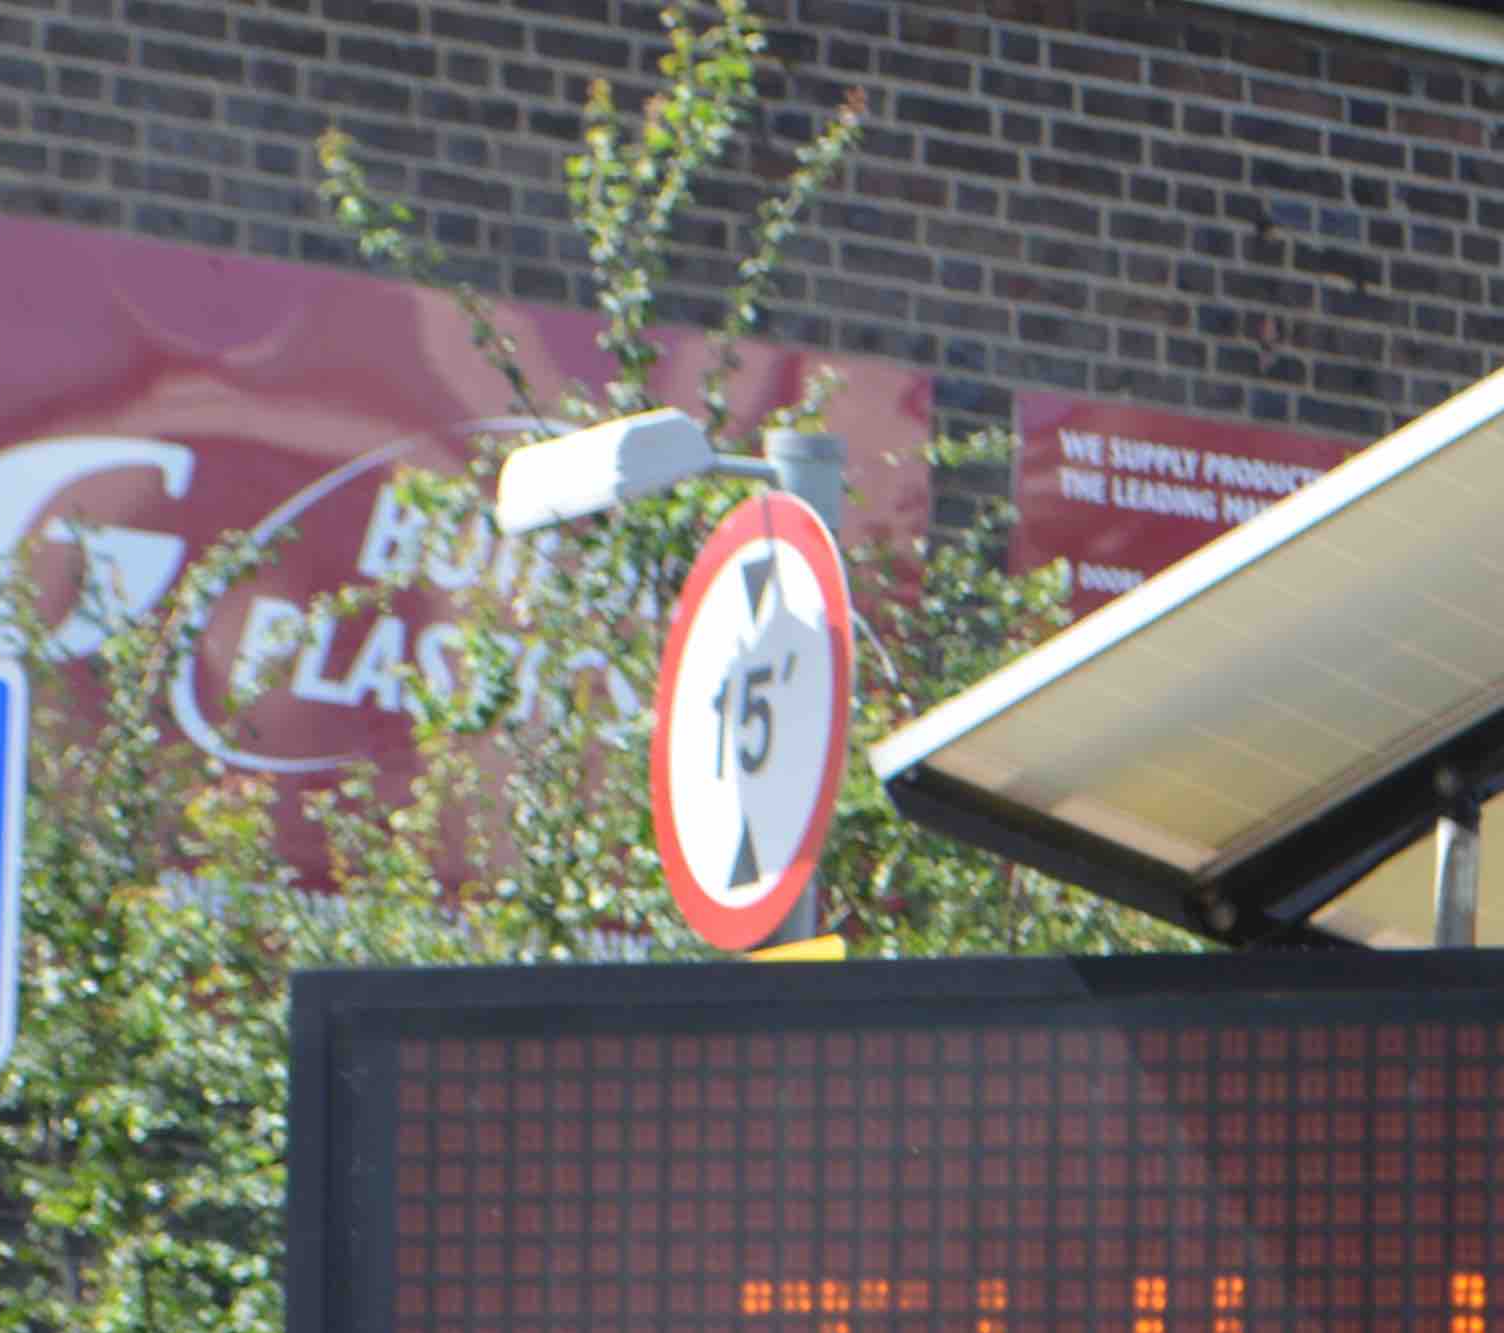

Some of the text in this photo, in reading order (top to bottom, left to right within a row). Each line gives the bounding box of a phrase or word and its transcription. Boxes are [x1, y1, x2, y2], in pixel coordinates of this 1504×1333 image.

[1058, 428, 1104, 466] WE
[1110, 436, 1198, 481] SUPPLY
[1060, 468, 1107, 505] THE
[1113, 476, 1218, 523] LEADING
